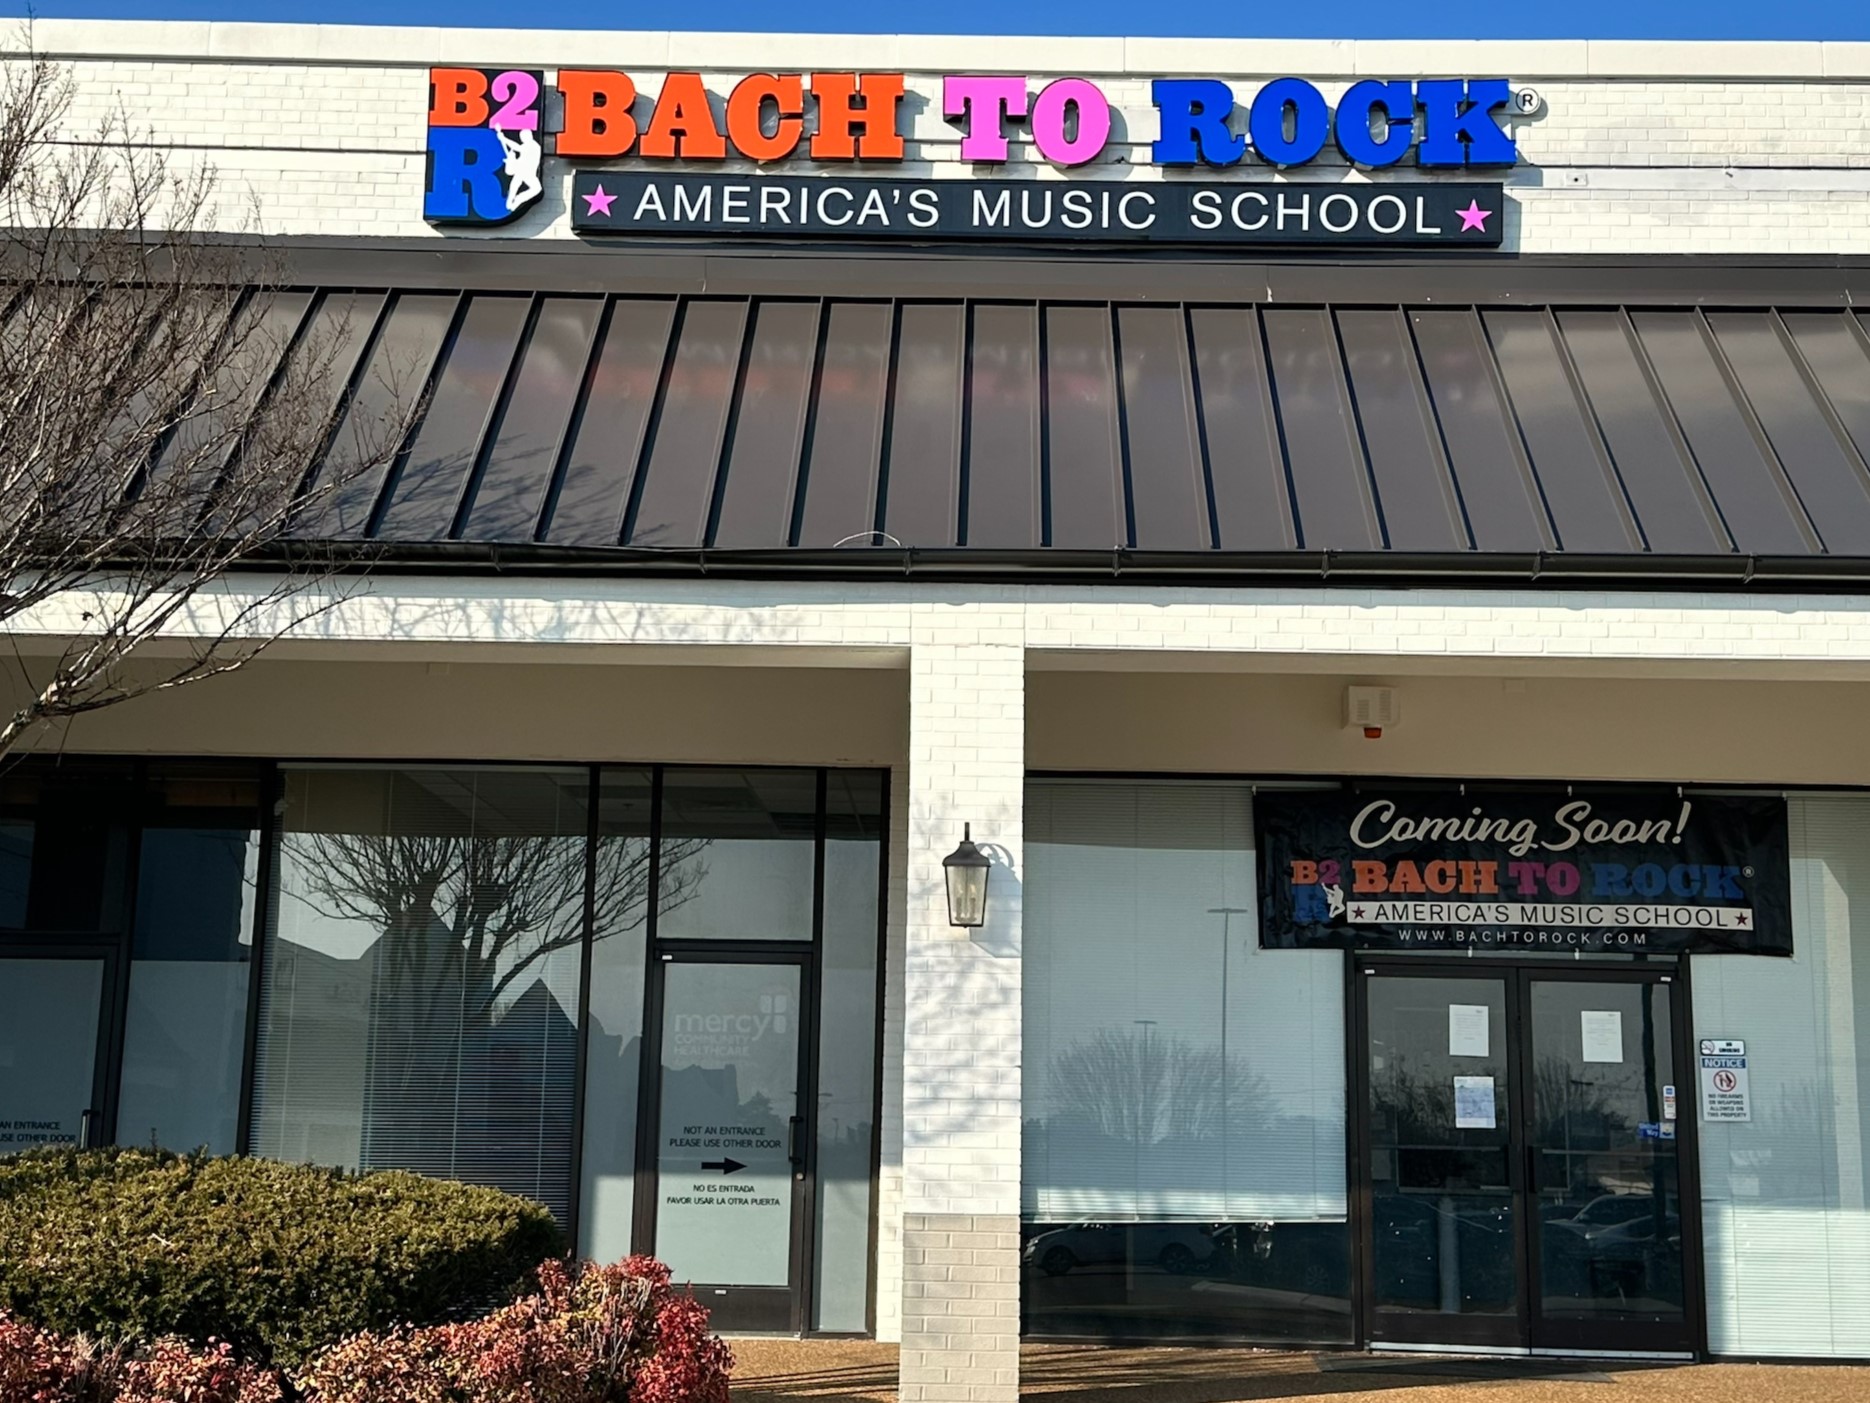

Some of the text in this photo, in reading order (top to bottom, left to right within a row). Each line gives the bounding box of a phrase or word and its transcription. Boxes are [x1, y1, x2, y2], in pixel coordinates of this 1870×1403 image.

[556, 69, 905, 160] BACH
[944, 76, 1110, 166] TO
[1152, 77, 1517, 168] ROCK
[633, 183, 1442, 234] AMERICA'S MUSIC SCHOOL
[1349, 800, 1692, 856] Coming Soon!
[1352, 860, 1498, 894] BACH
[1508, 862, 1580, 896] TO
[1591, 863, 1744, 899] ROCK
[1374, 903, 1728, 928] AMERICA'S MUSIC SCHOOL
[1399, 929, 1646, 945] WWW.BACHTOROCK.COM
[674, 1014, 771, 1042] mercy
[1704, 1059, 1743, 1067] NOTICE
[14, 1121, 60, 1130] ENTRANCE
[684, 1126, 766, 1136] NOT AN ENTRANCE
[0, 1133, 76, 1142] SE OTHER DOOR
[669, 1138, 782, 1148] PLEASE USE OTHER DOOR
[693, 1184, 755, 1193] NO ES ENTRADA
[667, 1197, 780, 1206] FAVOR USAR LA OTRA PUERTA
